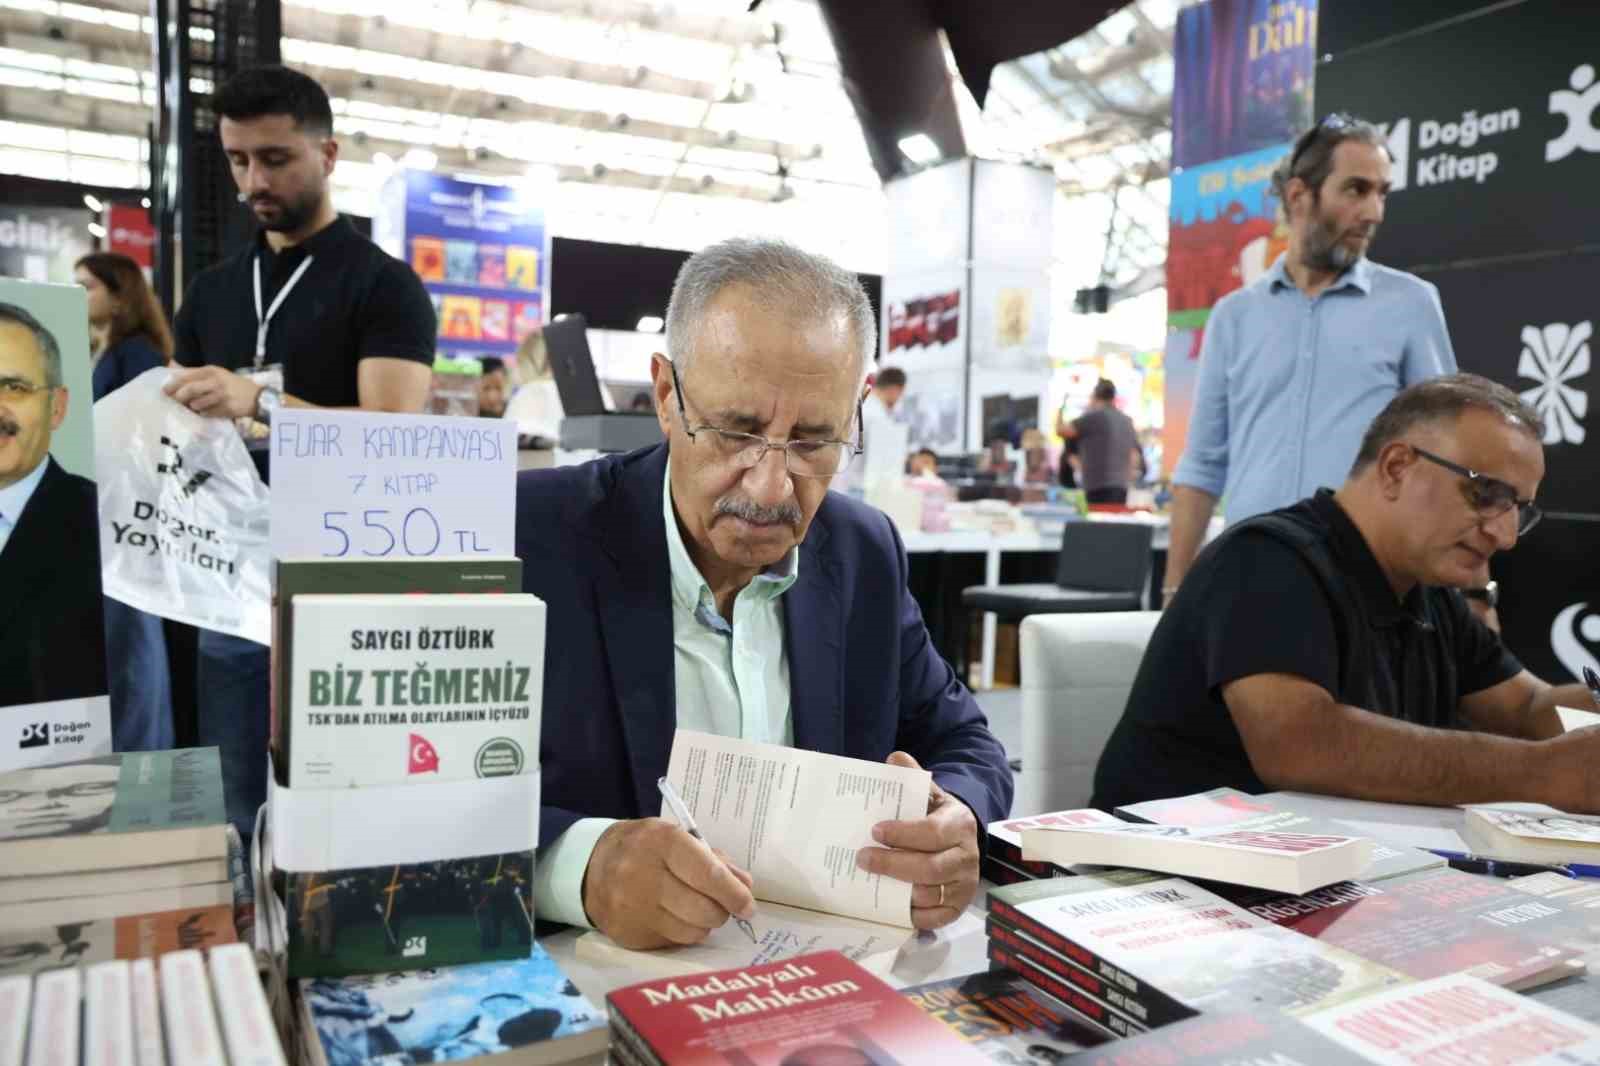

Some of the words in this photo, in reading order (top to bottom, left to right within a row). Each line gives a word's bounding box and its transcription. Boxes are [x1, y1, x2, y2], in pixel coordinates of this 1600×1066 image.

[1418, 107, 1521, 149] Doğan
[1416, 151, 1499, 187] Kitap
[278, 421, 344, 458] FUAR
[362, 425, 503, 462] KAMPANYASI
[348, 473, 368, 495] 7
[321, 507, 441, 558] 550
[453, 529, 492, 553] TL
[351, 629, 412, 651] SAYGI
[417, 626, 495, 650] ÖZTÜRK
[308, 662, 364, 707] BİZ
[371, 660, 531, 706] TEĞMENİZ
[53, 721, 92, 733] Doğan
[307, 712, 360, 726] TSK'DAN
[363, 712, 408, 725] ATILMA
[410, 708, 486, 725] OLAYLARININ
[488, 705, 530, 722] İÇYÜZÜ
[53, 734, 85, 745] Kitap
[639, 962, 818, 1007] Madalyalı
[690, 980, 862, 1024] Mahkûm
